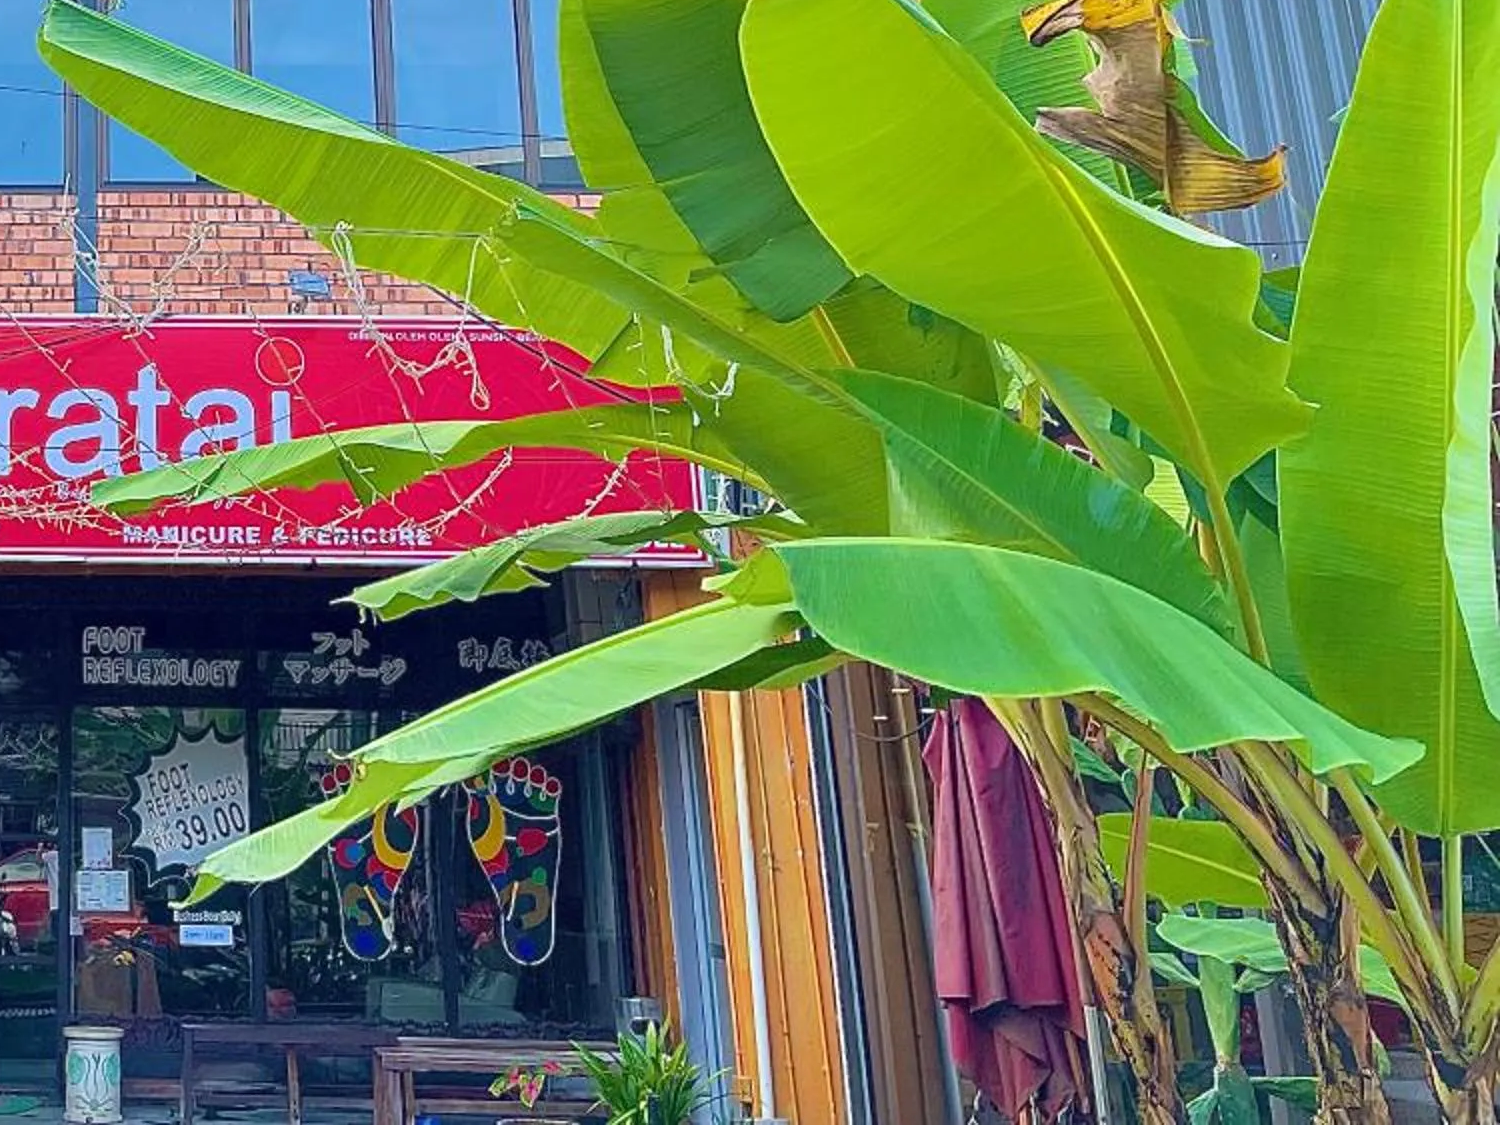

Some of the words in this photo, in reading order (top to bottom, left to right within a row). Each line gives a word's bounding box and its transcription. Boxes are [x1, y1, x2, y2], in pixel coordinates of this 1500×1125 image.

[122, 525, 260, 544] MANICURE
[82, 627, 145, 654] FOOT
[82, 658, 241, 687] REFLEXOLOGY
[147, 762, 190, 797] FOOT
[145, 775, 245, 819] REFLEXOLOGY
[175, 802, 246, 850] 39.00
